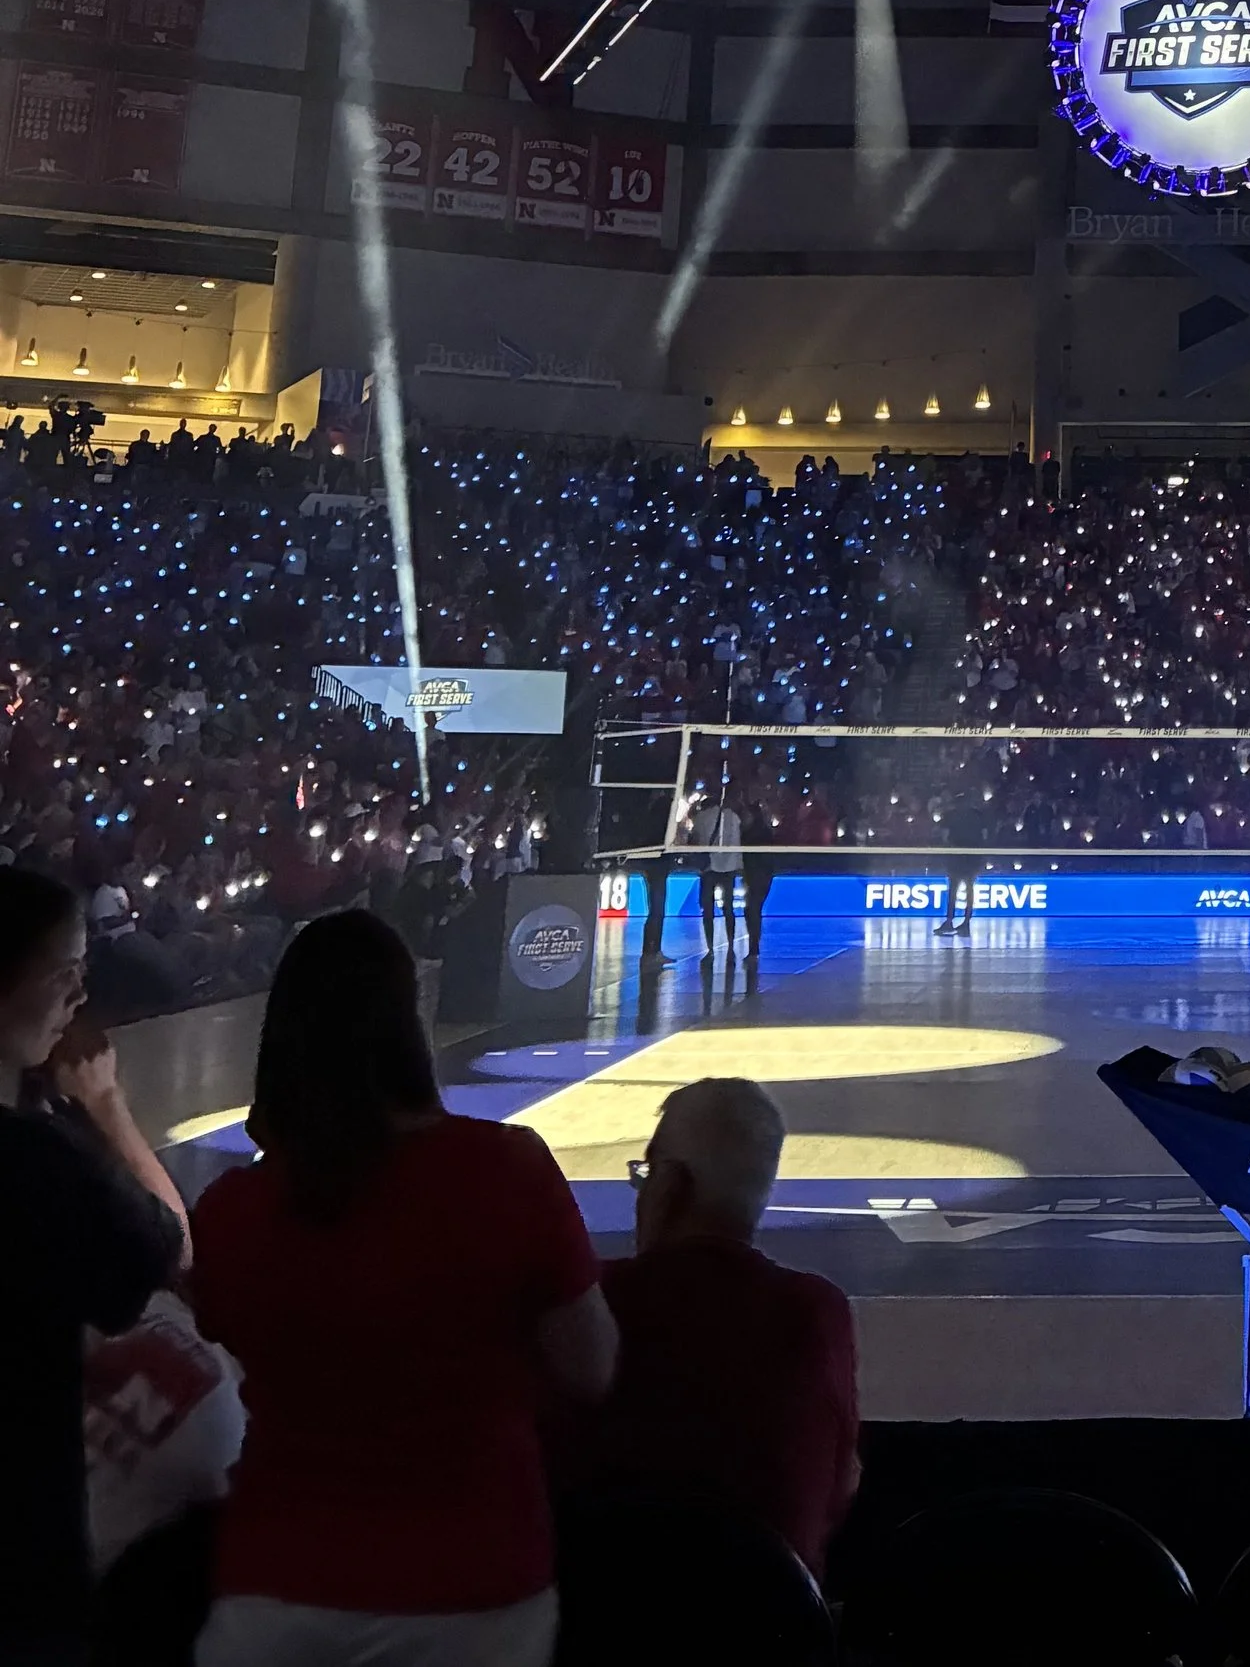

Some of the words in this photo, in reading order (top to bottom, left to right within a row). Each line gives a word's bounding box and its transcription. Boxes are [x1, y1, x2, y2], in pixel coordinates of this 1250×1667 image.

[1108, 35, 1197, 67] FIRST
[362, 136, 422, 177] 22
[444, 147, 501, 186] 42
[526, 157, 582, 197] 52
[609, 165, 652, 203] 10
[517, 202, 537, 219] N
[598, 210, 616, 227] N
[1068, 206, 1174, 244] Bryan
[406, 693, 439, 706] FIRST
[439, 692, 474, 705] SERVE
[422, 681, 460, 694] AVCA
[600, 875, 628, 911] 18
[866, 884, 947, 909] FIRST
[954, 882, 1047, 909] SERVE
[1195, 890, 1250, 908] AVCA
[533, 929, 570, 943] AVCA
